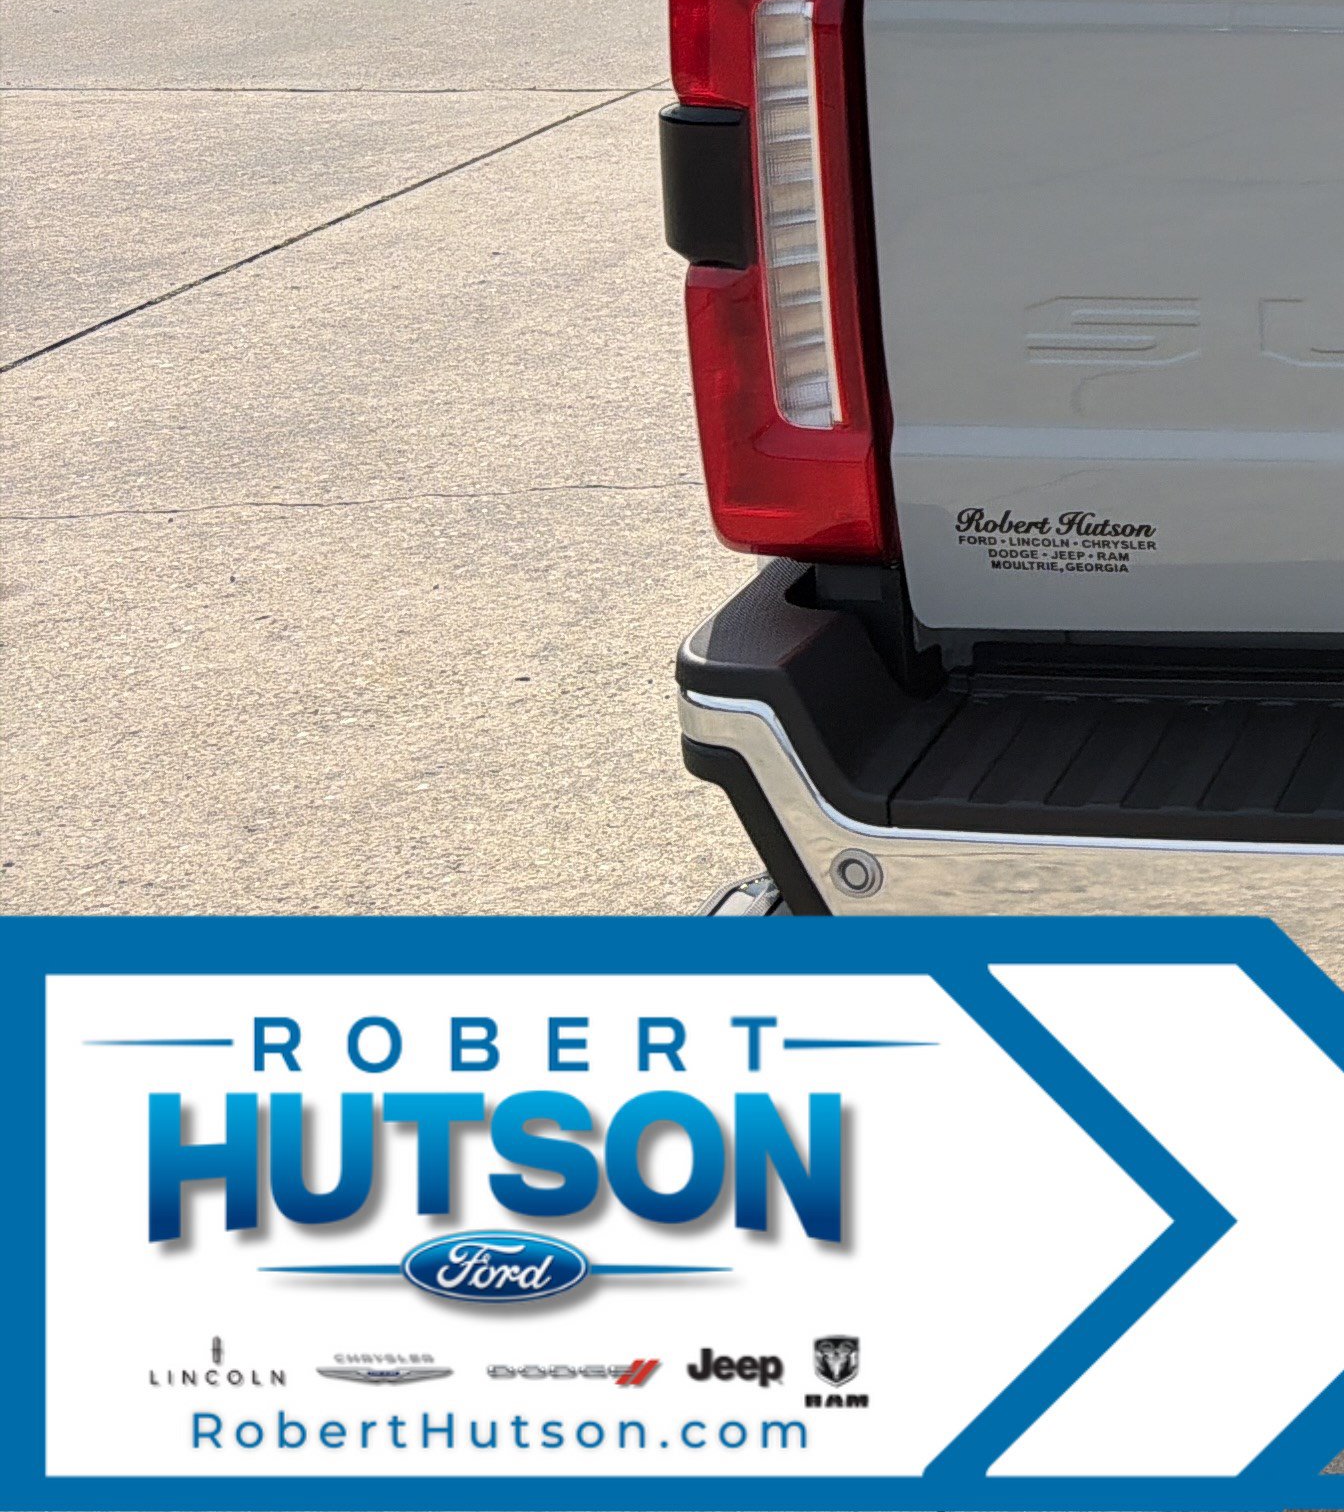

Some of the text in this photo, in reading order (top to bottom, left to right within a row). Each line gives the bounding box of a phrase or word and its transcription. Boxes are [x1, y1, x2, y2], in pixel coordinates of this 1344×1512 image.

[955, 507, 1157, 538] Robert Hutson
[958, 535, 1157, 551] FORD LINCOLN CHRYSLER
[988, 549, 1130, 562] DODGE JEEP RAM
